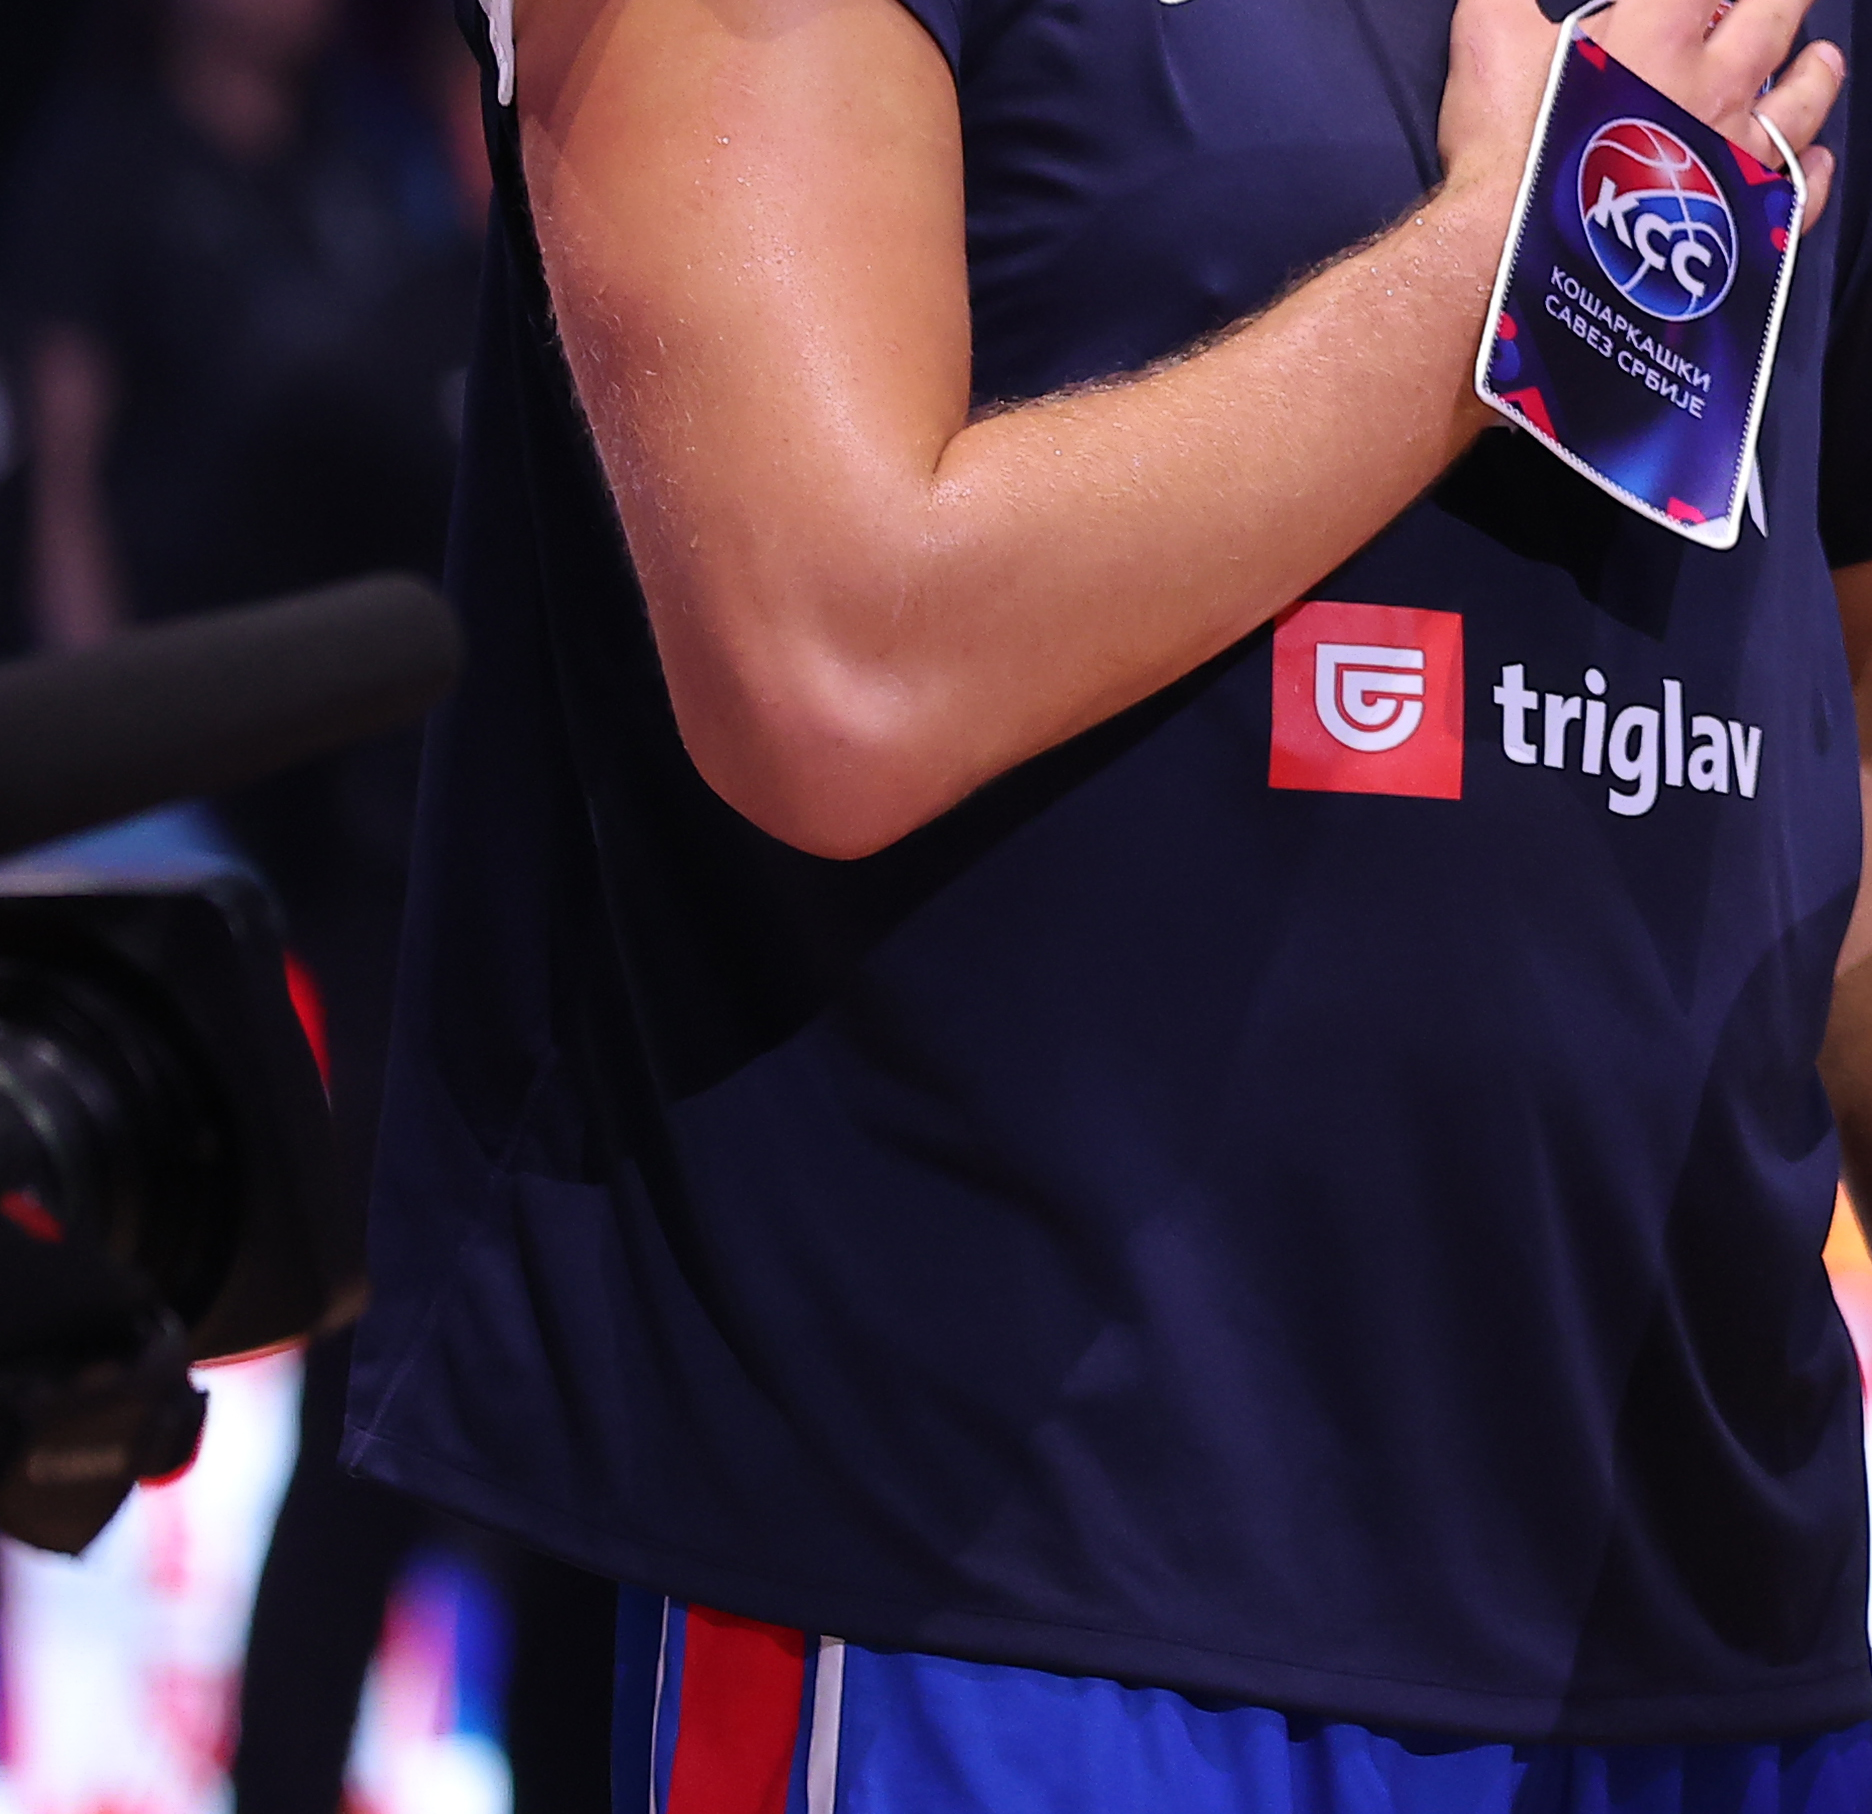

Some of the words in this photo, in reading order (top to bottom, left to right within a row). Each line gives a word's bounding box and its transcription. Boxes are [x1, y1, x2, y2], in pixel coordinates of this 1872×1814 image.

[1594, 175, 1713, 298] КСС
[1544, 294, 1615, 359] САВЕЗ
[1617, 350, 1707, 420] СРБИЈЕ
[1550, 265, 1712, 393] КОШАРКАШКИ
[1493, 662, 1763, 817] triglav
